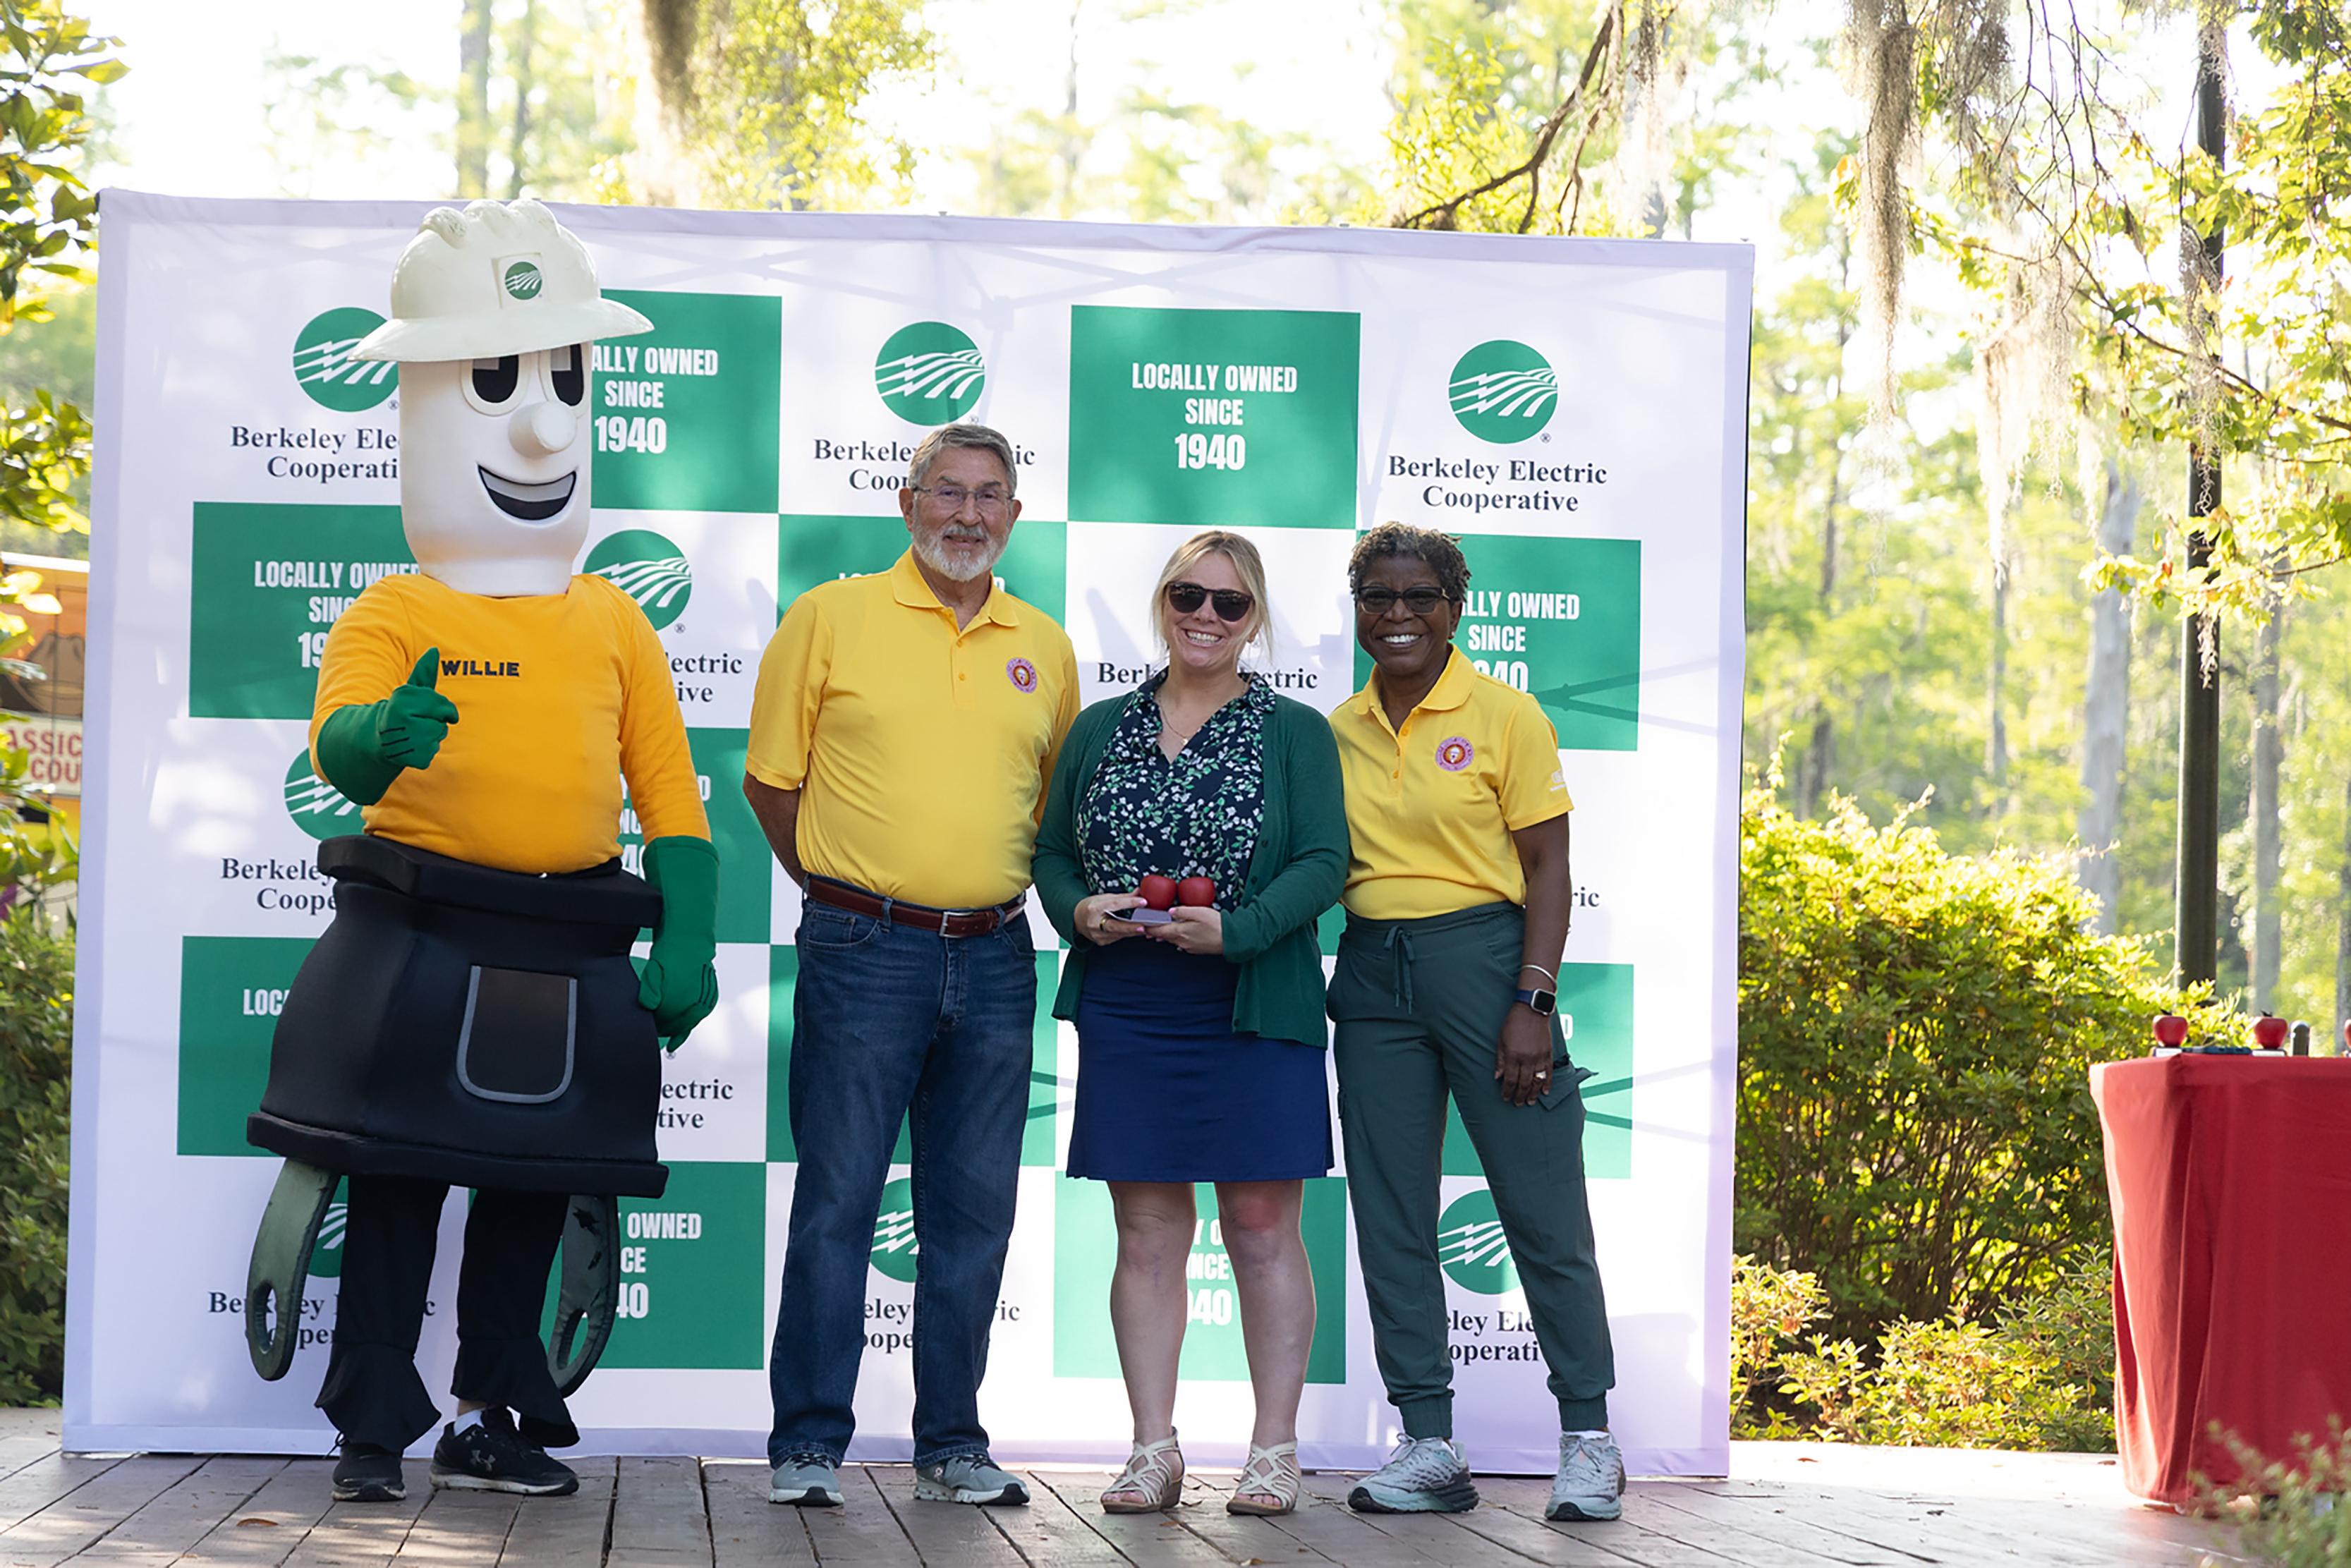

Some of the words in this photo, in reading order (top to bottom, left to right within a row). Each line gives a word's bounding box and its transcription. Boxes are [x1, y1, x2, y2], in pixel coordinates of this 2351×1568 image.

[591, 345, 638, 373] ALLY
[644, 347, 718, 376] OWNED
[1132, 363, 1219, 391] LOCALLY
[1225, 365, 1298, 393] OWNED
[605, 379, 664, 408] SINCE
[1185, 398, 1244, 425] SINCE
[231, 425, 346, 454] Berkeley
[595, 415, 667, 454] 1940
[814, 439, 916, 462] Berkele
[1174, 433, 1246, 470] 1940
[267, 455, 398, 485] Cooperati
[1388, 455, 1500, 485] Berkeley
[1509, 460, 1608, 484] Electric
[1423, 485, 1579, 513] Cooperative
[255, 561, 344, 588] LOCALLY
[308, 596, 356, 623] SIN
[1507, 592, 1580, 620] OWNED
[298, 632, 329, 668] 19
[1468, 624, 1526, 652] SINCE
[441, 660, 520, 676] WILLIE
[665, 652, 742, 674] ectric
[1097, 662, 1158, 683] Berk
[662, 1078, 733, 1100] ectric
[627, 1212, 702, 1239] OWNED
[865, 1299, 911, 1325] eley
[1450, 1341, 1539, 1366] operati
